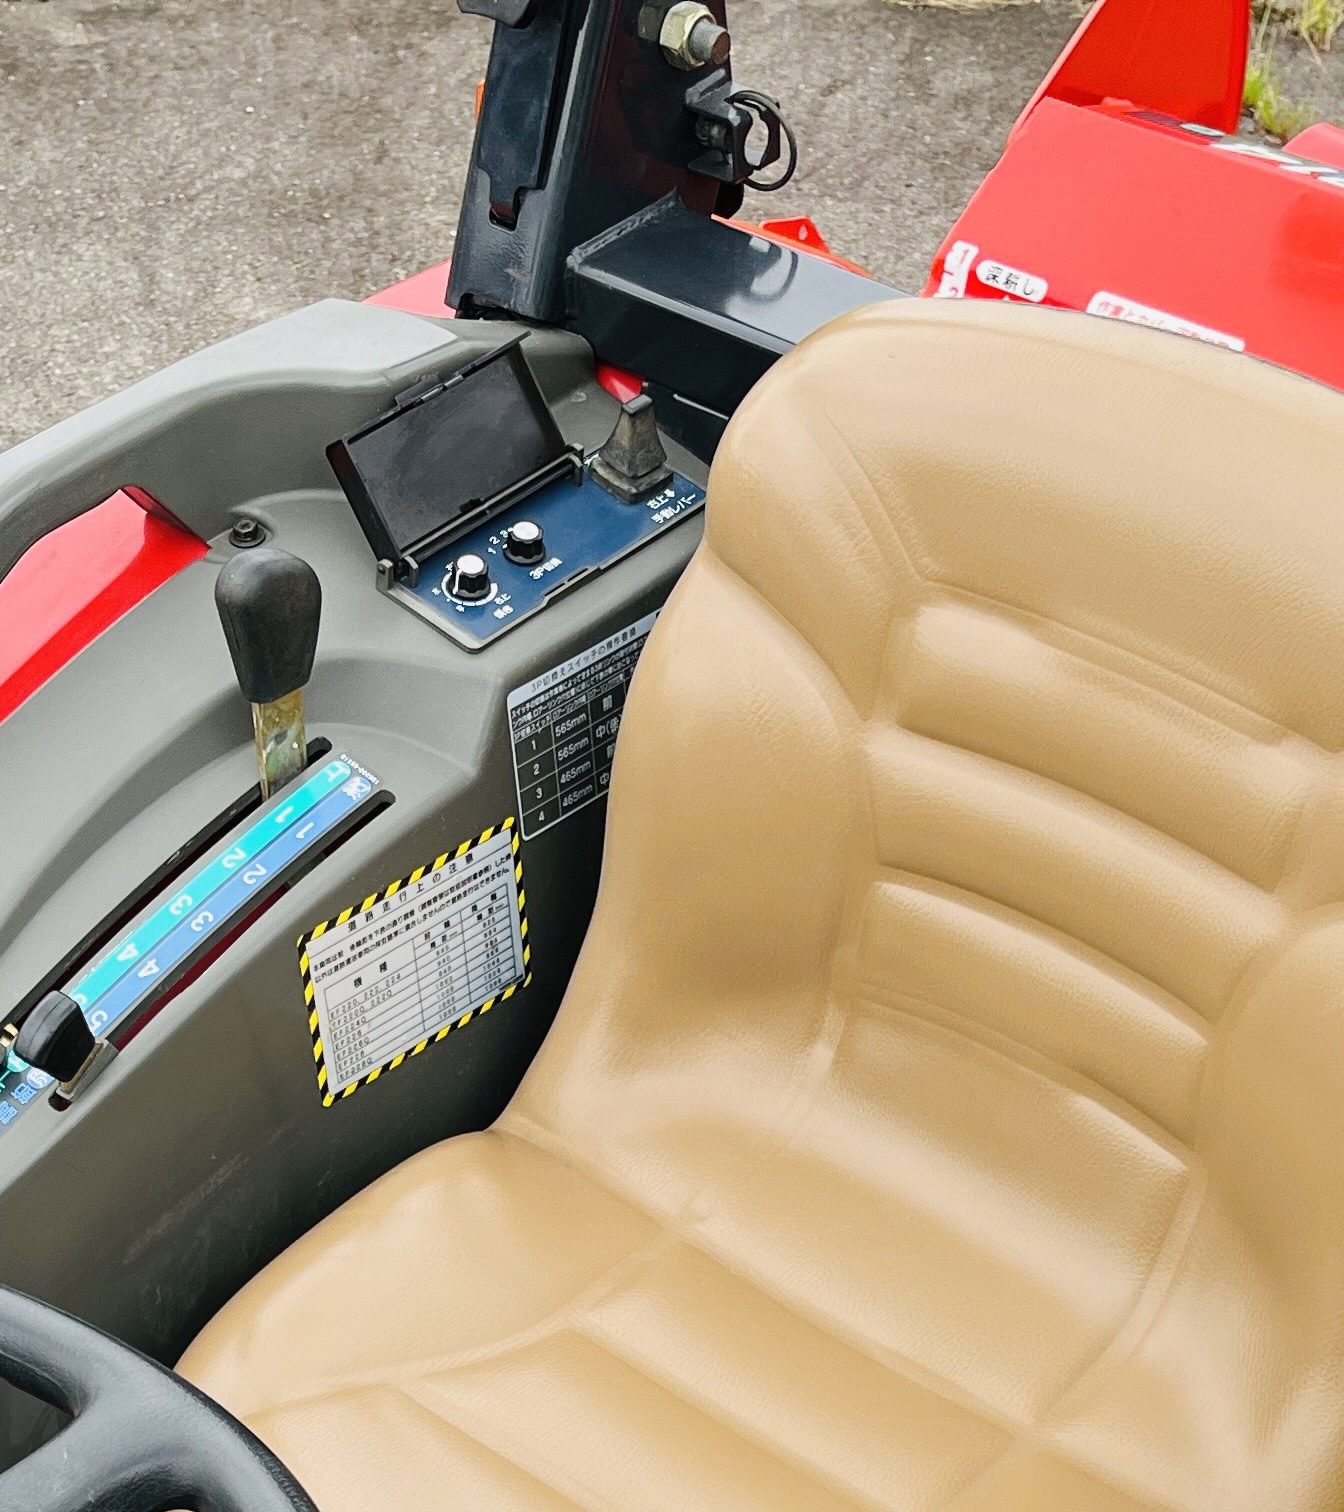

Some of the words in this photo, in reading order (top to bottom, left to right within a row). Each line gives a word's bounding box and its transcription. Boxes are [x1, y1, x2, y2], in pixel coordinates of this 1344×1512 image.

[489, 536, 500, 545] 2
[531, 738, 536, 752] 1
[555, 708, 586, 739] 565mm
[532, 761, 540, 776] 2
[557, 732, 588, 763] 565mm
[535, 785, 542, 800] 3
[559, 755, 590, 787] 465mm
[538, 809, 544, 823] 4
[562, 778, 592, 811] 465mm
[274, 805, 294, 823] 1
[295, 822, 315, 840] 1
[222, 848, 246, 869] 2
[243, 863, 268, 886] 2
[168, 895, 193, 917] 3
[190, 911, 214, 932] 3
[116, 943, 140, 962] 4
[138, 958, 160, 979] 4
[88, 1010, 109, 1029] 5
